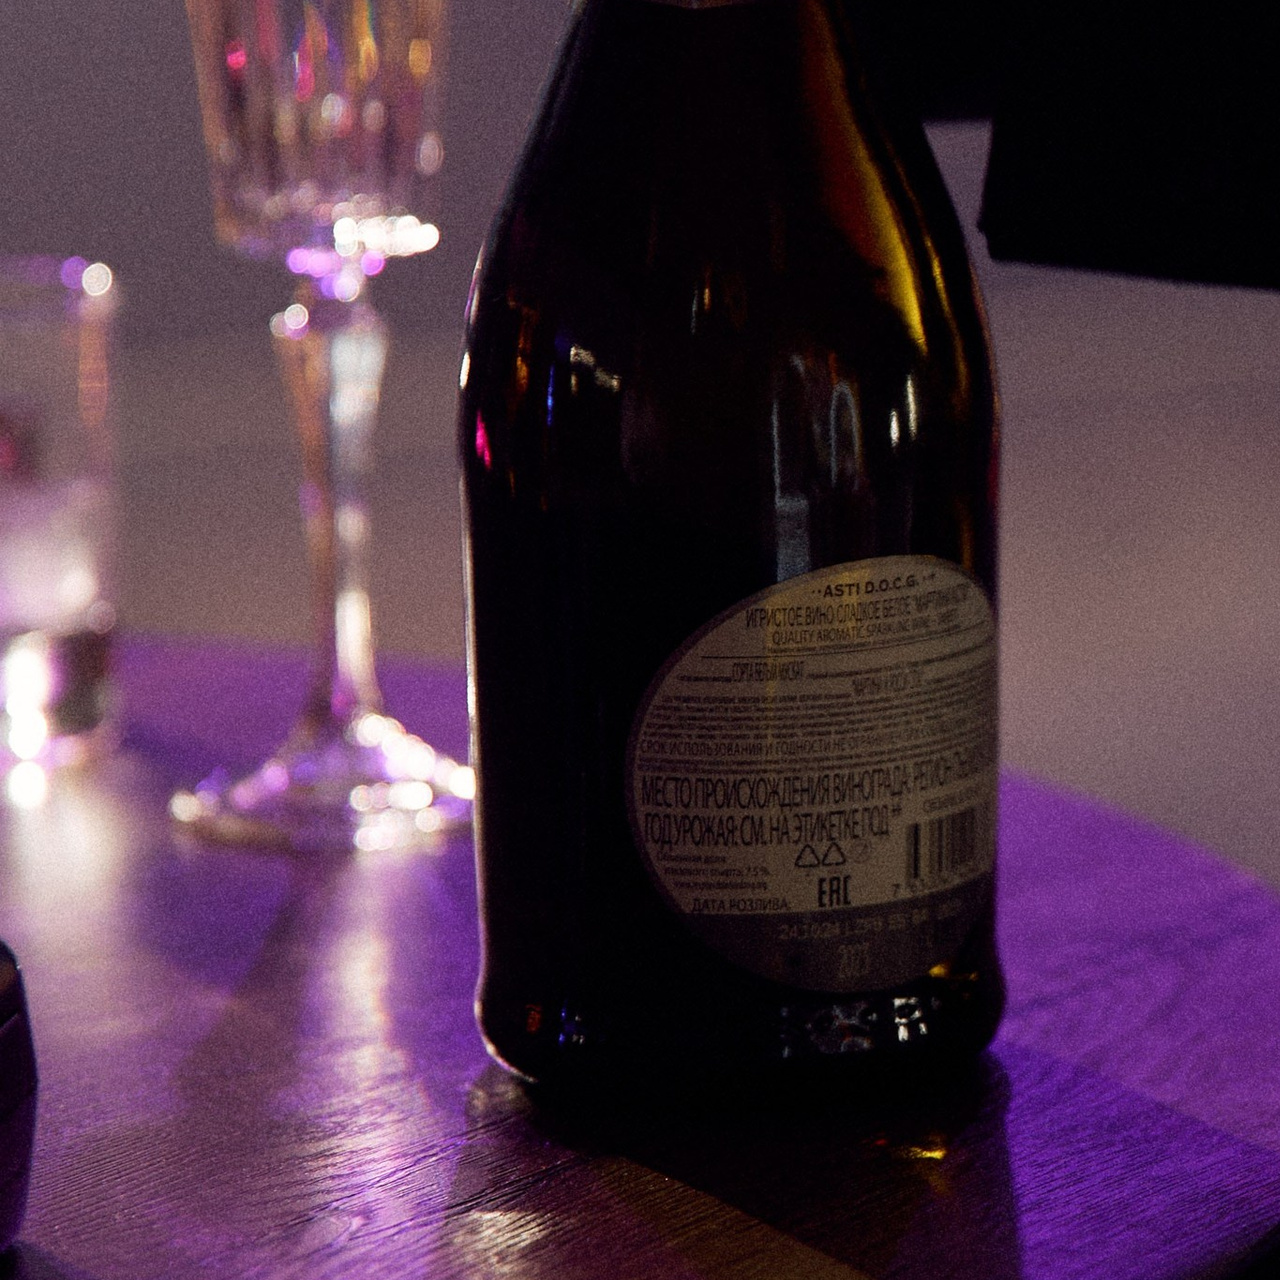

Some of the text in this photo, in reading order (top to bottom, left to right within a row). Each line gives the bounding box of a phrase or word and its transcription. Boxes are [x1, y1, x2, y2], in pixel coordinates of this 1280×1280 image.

[823, 574, 919, 597] ASTI D.O.C.G.
[745, 605, 803, 628] ИГРИСТОЕ
[805, 604, 834, 626] ВИНО
[836, 600, 880, 623] СЛАДКОЕ
[772, 630, 814, 645] QUALITY
[817, 625, 864, 642] AROMATIC
[640, 739, 668, 754] СРОК
[669, 740, 764, 756] ИСПОЛЬЗОВАНИЯ
[775, 737, 831, 756] ГОДНОСТИ
[641, 775, 692, 808] МЕСТО
[694, 775, 830, 811] ПРОИСХОЖДЕНИЯ
[644, 813, 672, 851] ГОД
[674, 815, 738, 847] УРОЖАЯ:
[740, 815, 766, 846] СМ.
[769, 815, 790, 844] НА
[793, 809, 859, 844] ЭТИКЕТКЕ
[692, 898, 725, 912] ДАТА
